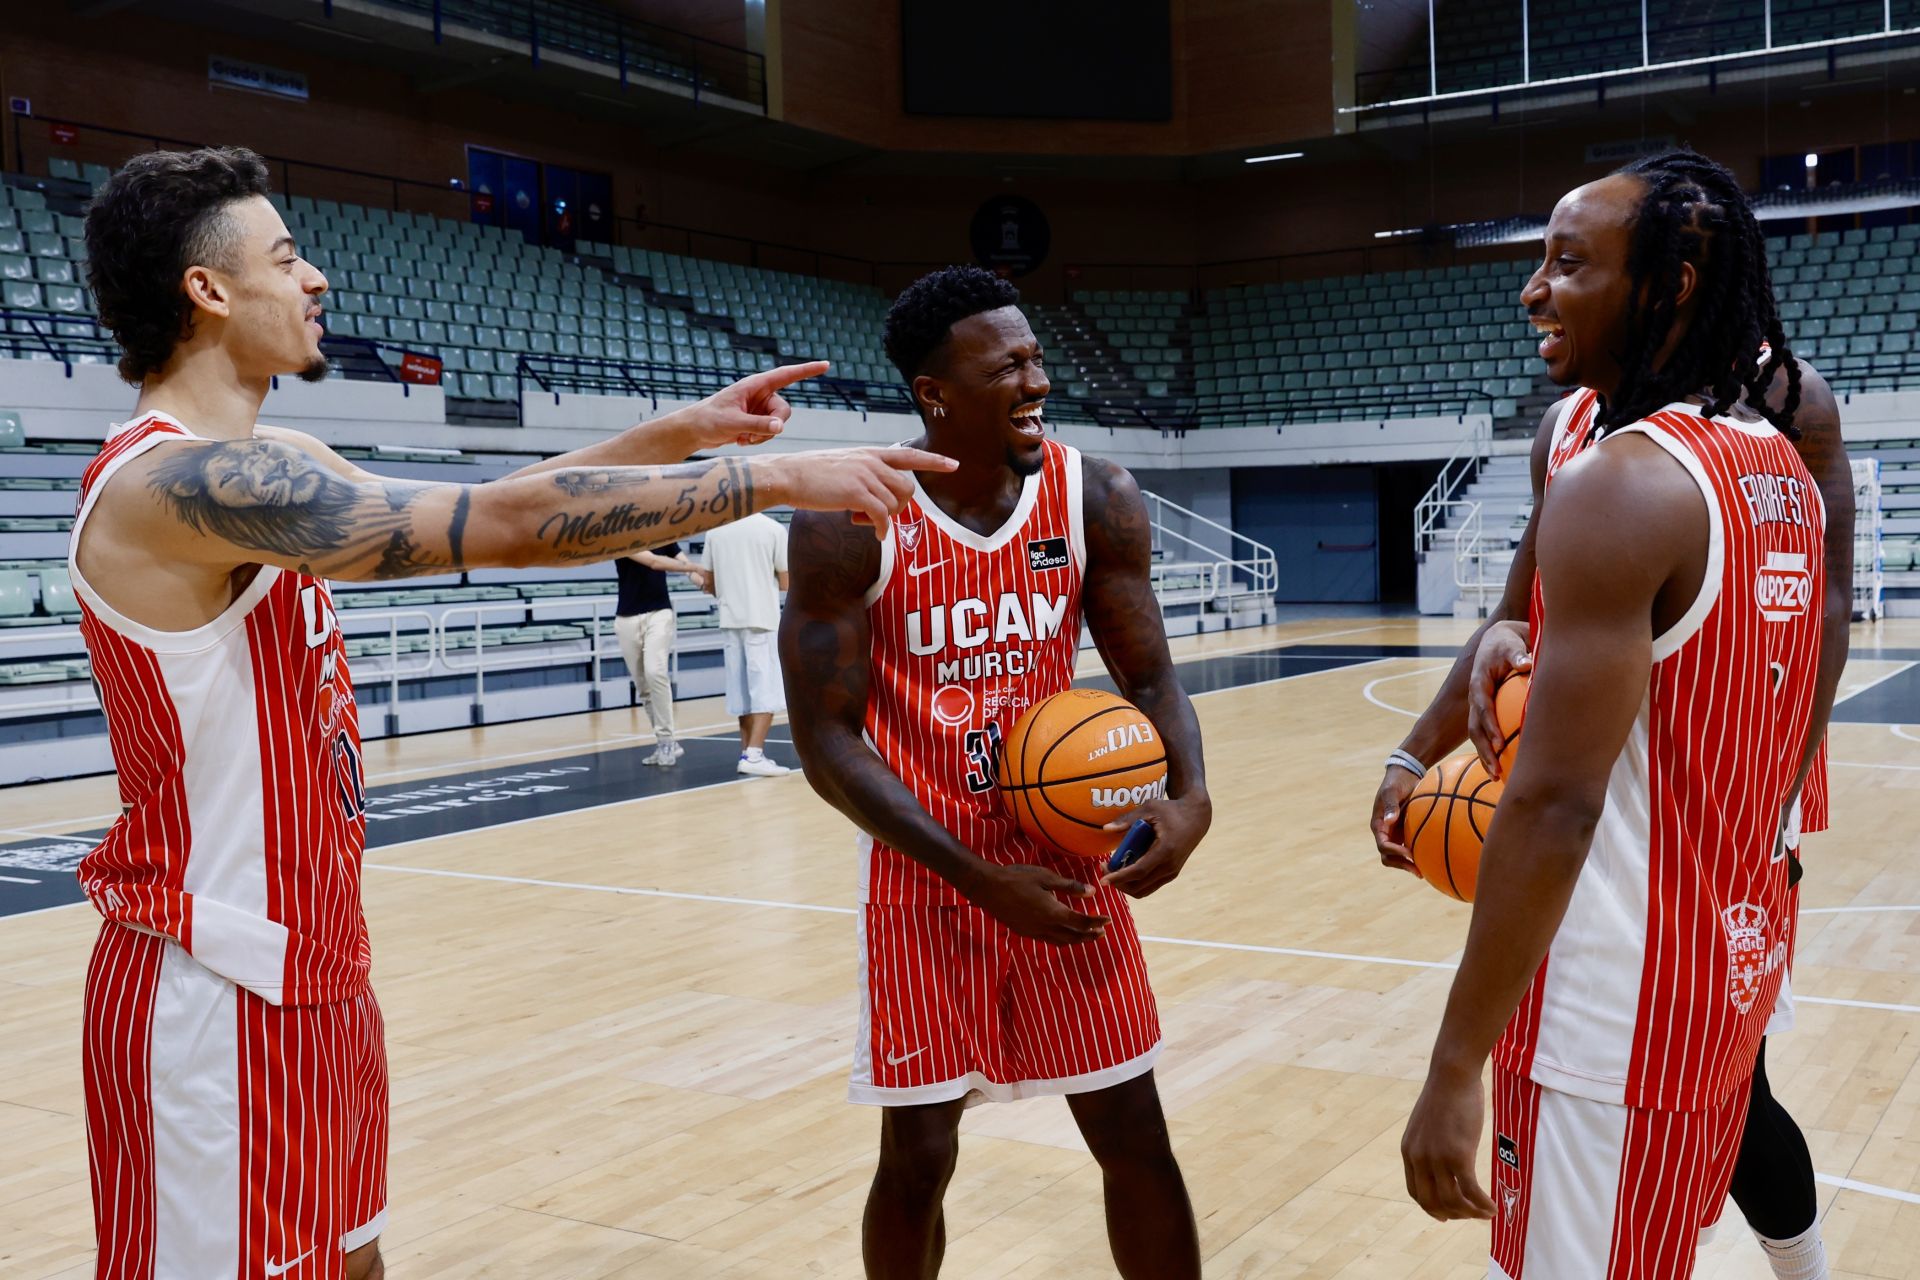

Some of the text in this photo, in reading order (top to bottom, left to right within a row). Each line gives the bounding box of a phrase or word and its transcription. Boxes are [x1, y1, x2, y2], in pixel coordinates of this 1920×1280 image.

[537, 502, 668, 549] Matthew
[669, 477, 733, 525] 5:8
[1031, 555, 1067, 568] endesa
[906, 591, 1068, 657] UCAM
[1087, 722, 1154, 762] EVO NXT
[364, 765, 591, 808] amiento
[1499, 1146, 1516, 1164] acb
